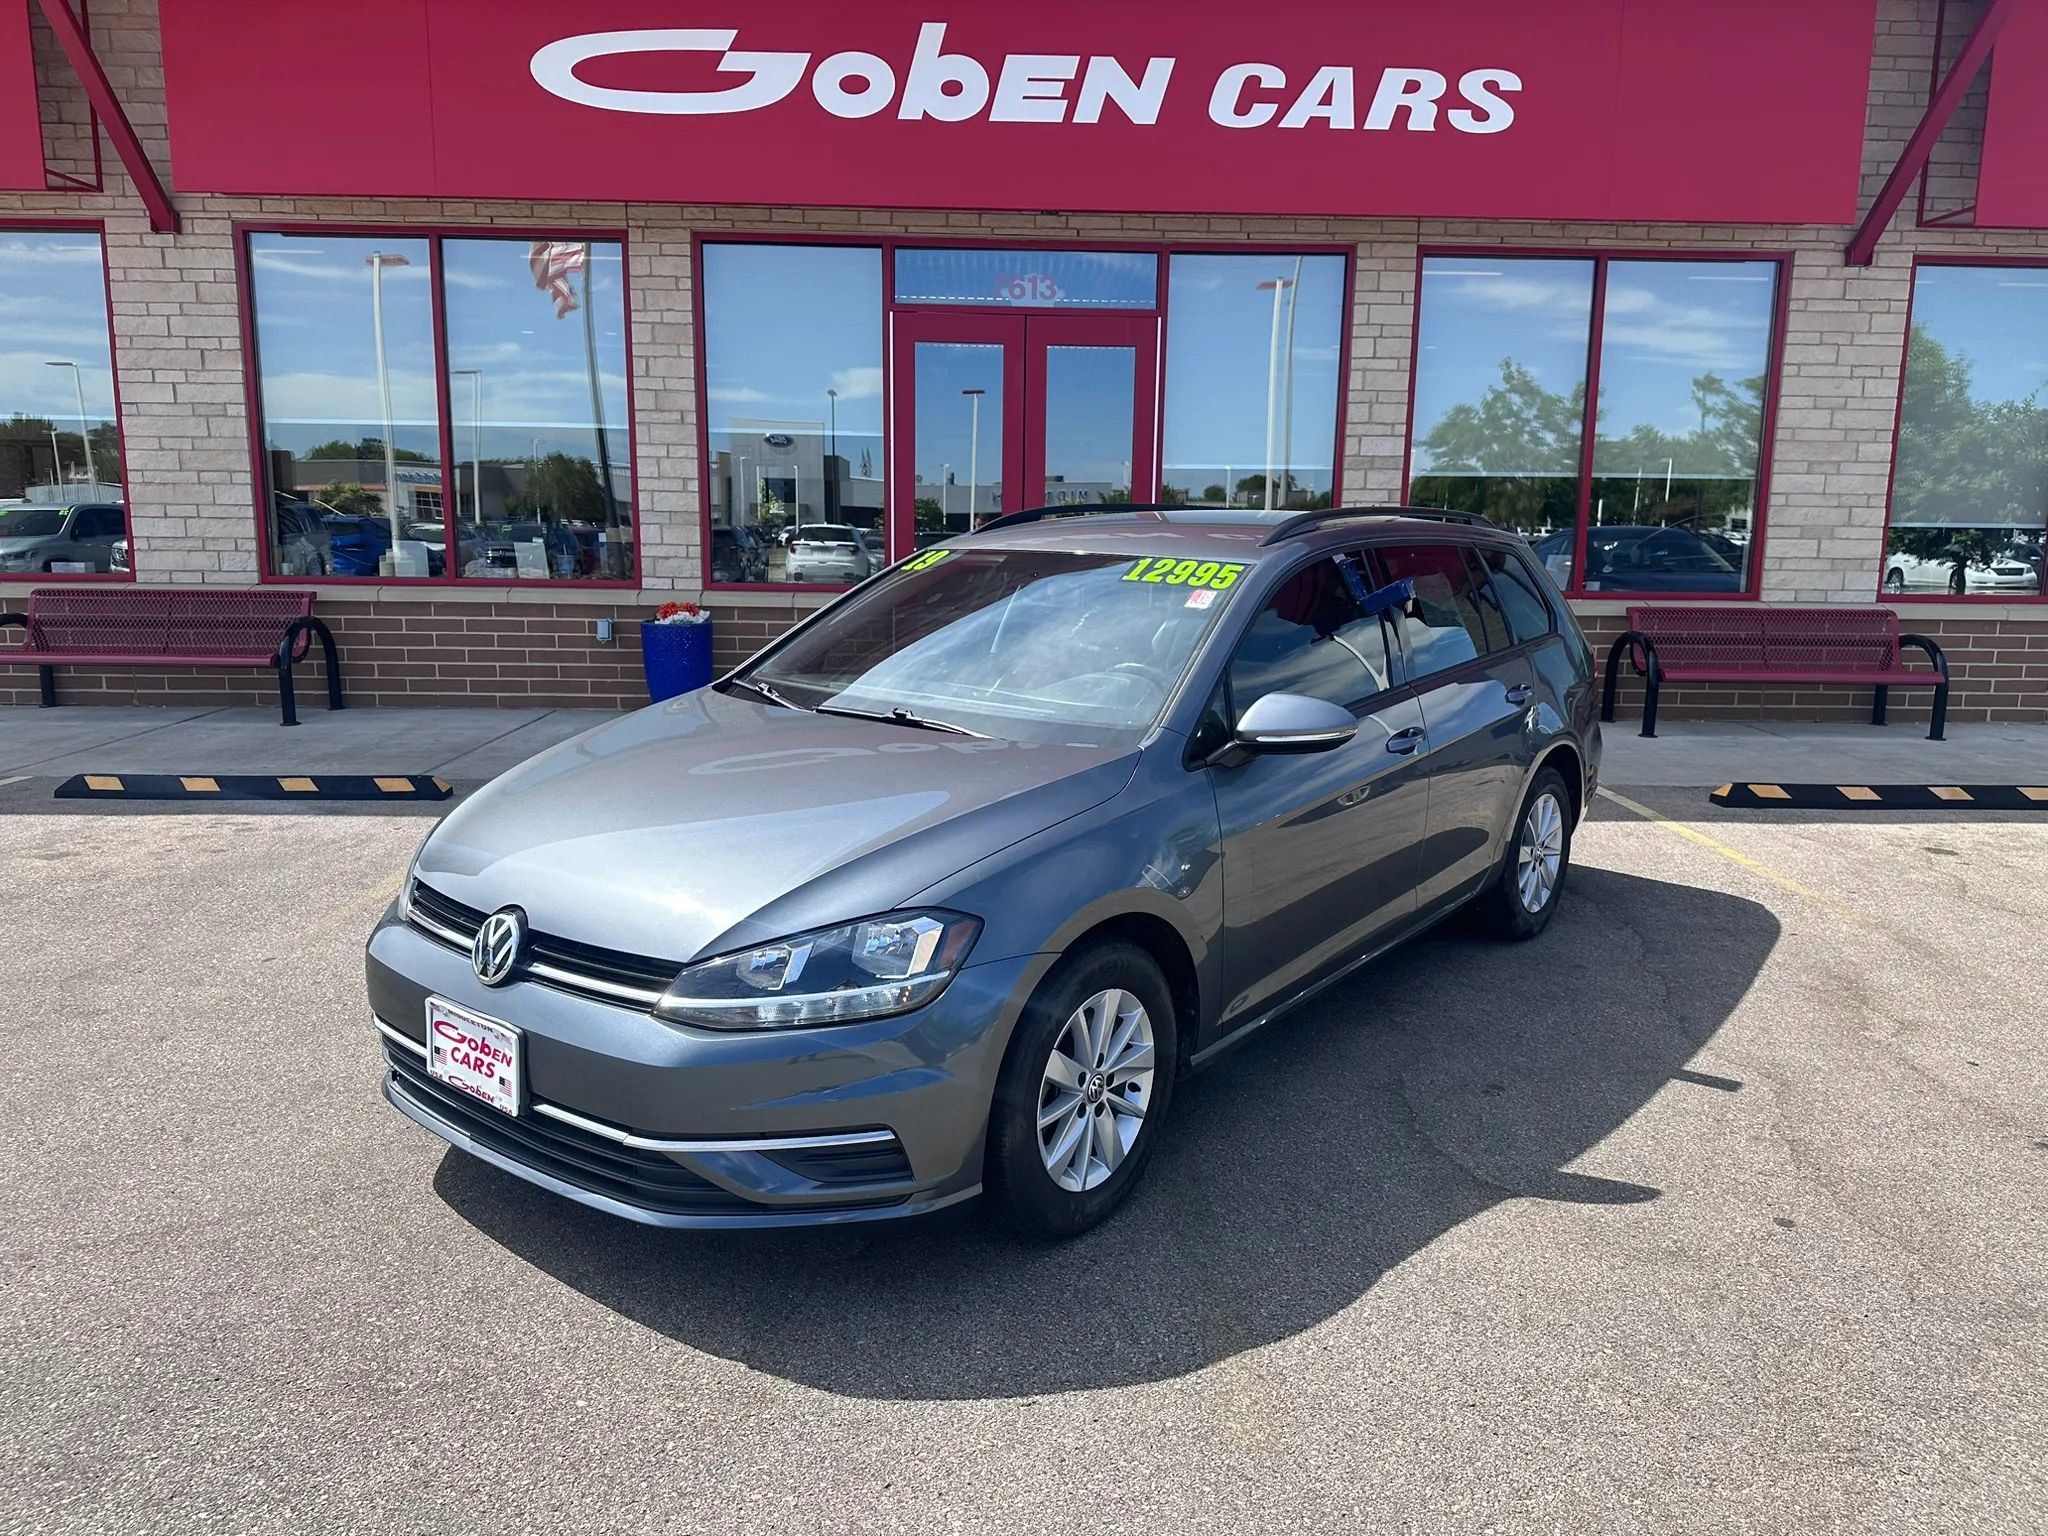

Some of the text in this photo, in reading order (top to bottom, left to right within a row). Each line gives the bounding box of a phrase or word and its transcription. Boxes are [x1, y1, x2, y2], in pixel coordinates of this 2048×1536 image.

[1208, 63, 1522, 133] CARS
[1008, 273, 1056, 300] 613
[901, 551, 949, 570] 19
[1122, 558, 1244, 589] 12995
[451, 1047, 495, 1078] CARS
